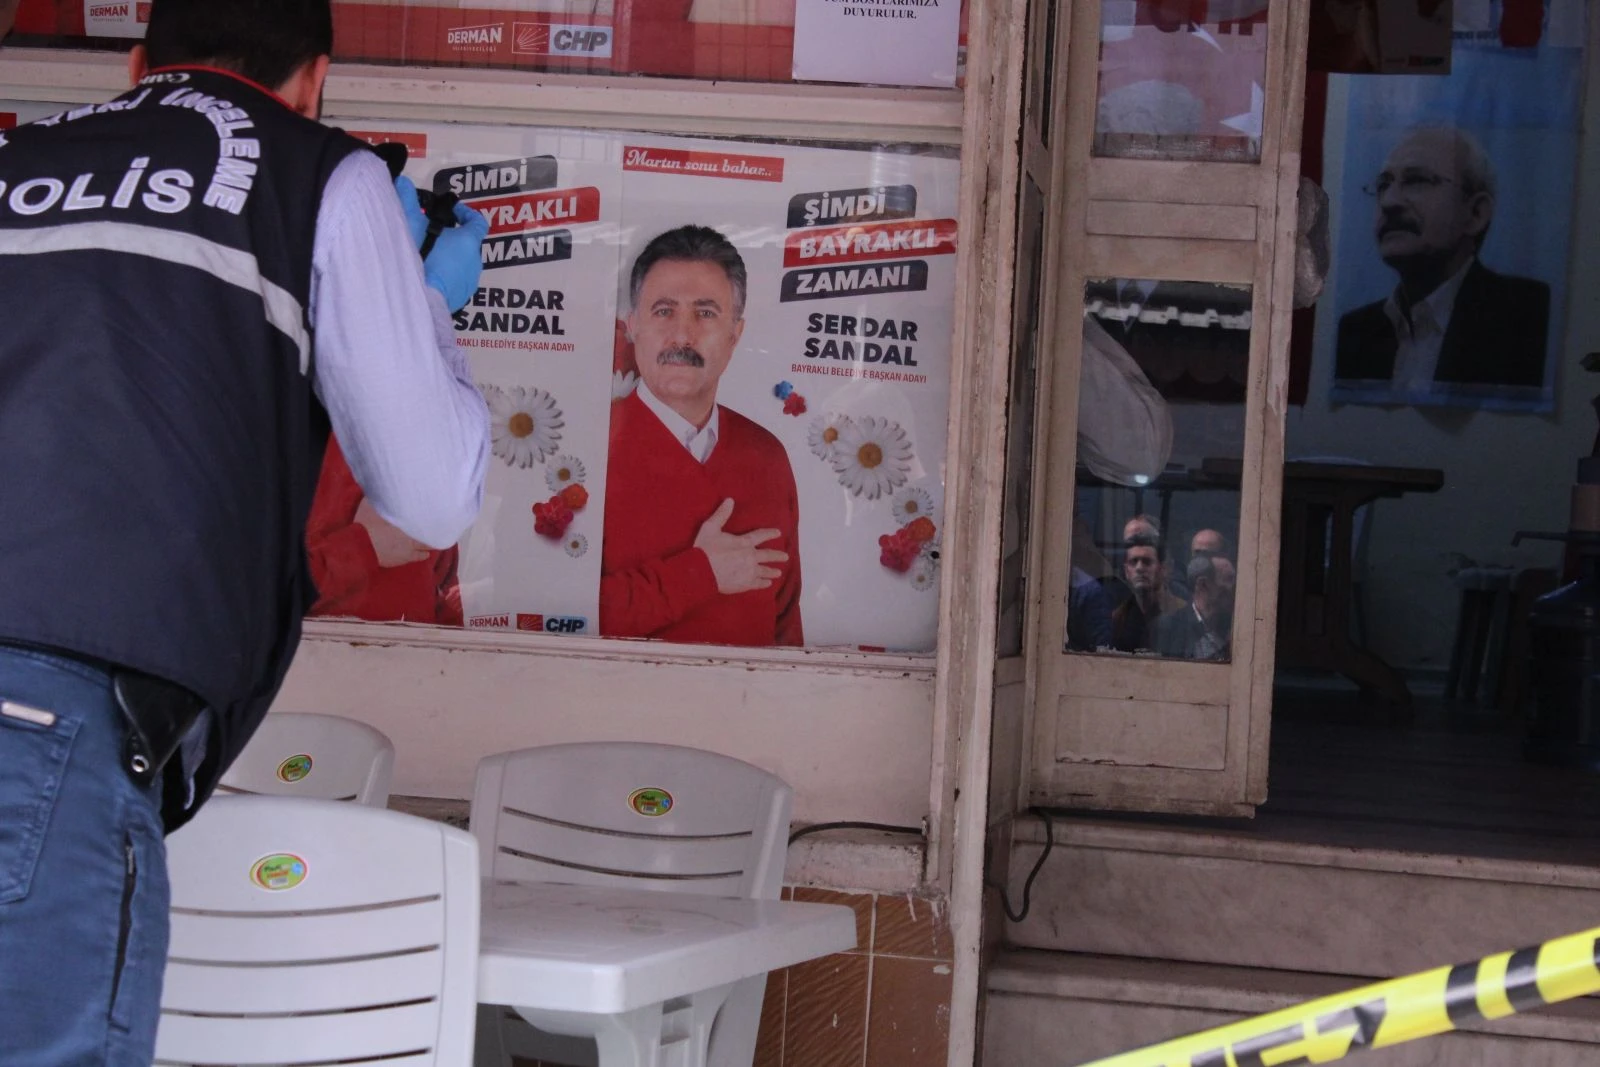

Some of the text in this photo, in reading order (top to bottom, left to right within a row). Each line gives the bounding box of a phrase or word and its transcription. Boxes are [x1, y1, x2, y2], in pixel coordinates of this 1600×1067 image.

[90, 5, 129, 17] DERMAN
[843, 7, 917, 19] DUYURULUR.
[447, 27, 502, 44] DERMAN
[553, 29, 608, 52] CHP
[626, 149, 772, 177] Martın sonu bahar...
[449, 158, 528, 199] ŞİMDİ
[481, 196, 578, 227] YRAKLI
[803, 187, 886, 227] ŞİMDİ
[481, 234, 555, 264] MANI
[799, 227, 936, 259] BAYRAKLI
[796, 265, 911, 295] ZAMANI
[452, 311, 565, 336] SANDAL
[806, 312, 918, 342] SERDAR
[456, 338, 575, 353] RAKLI BELEDİYE BAŞKAN ADAYI
[803, 337, 918, 367] SANDAL
[791, 363, 829, 375] BAYRAKLI
[869, 371, 902, 382] BAŞKAN
[902, 373, 927, 384] ADAYI
[546, 618, 585, 632] CHP
